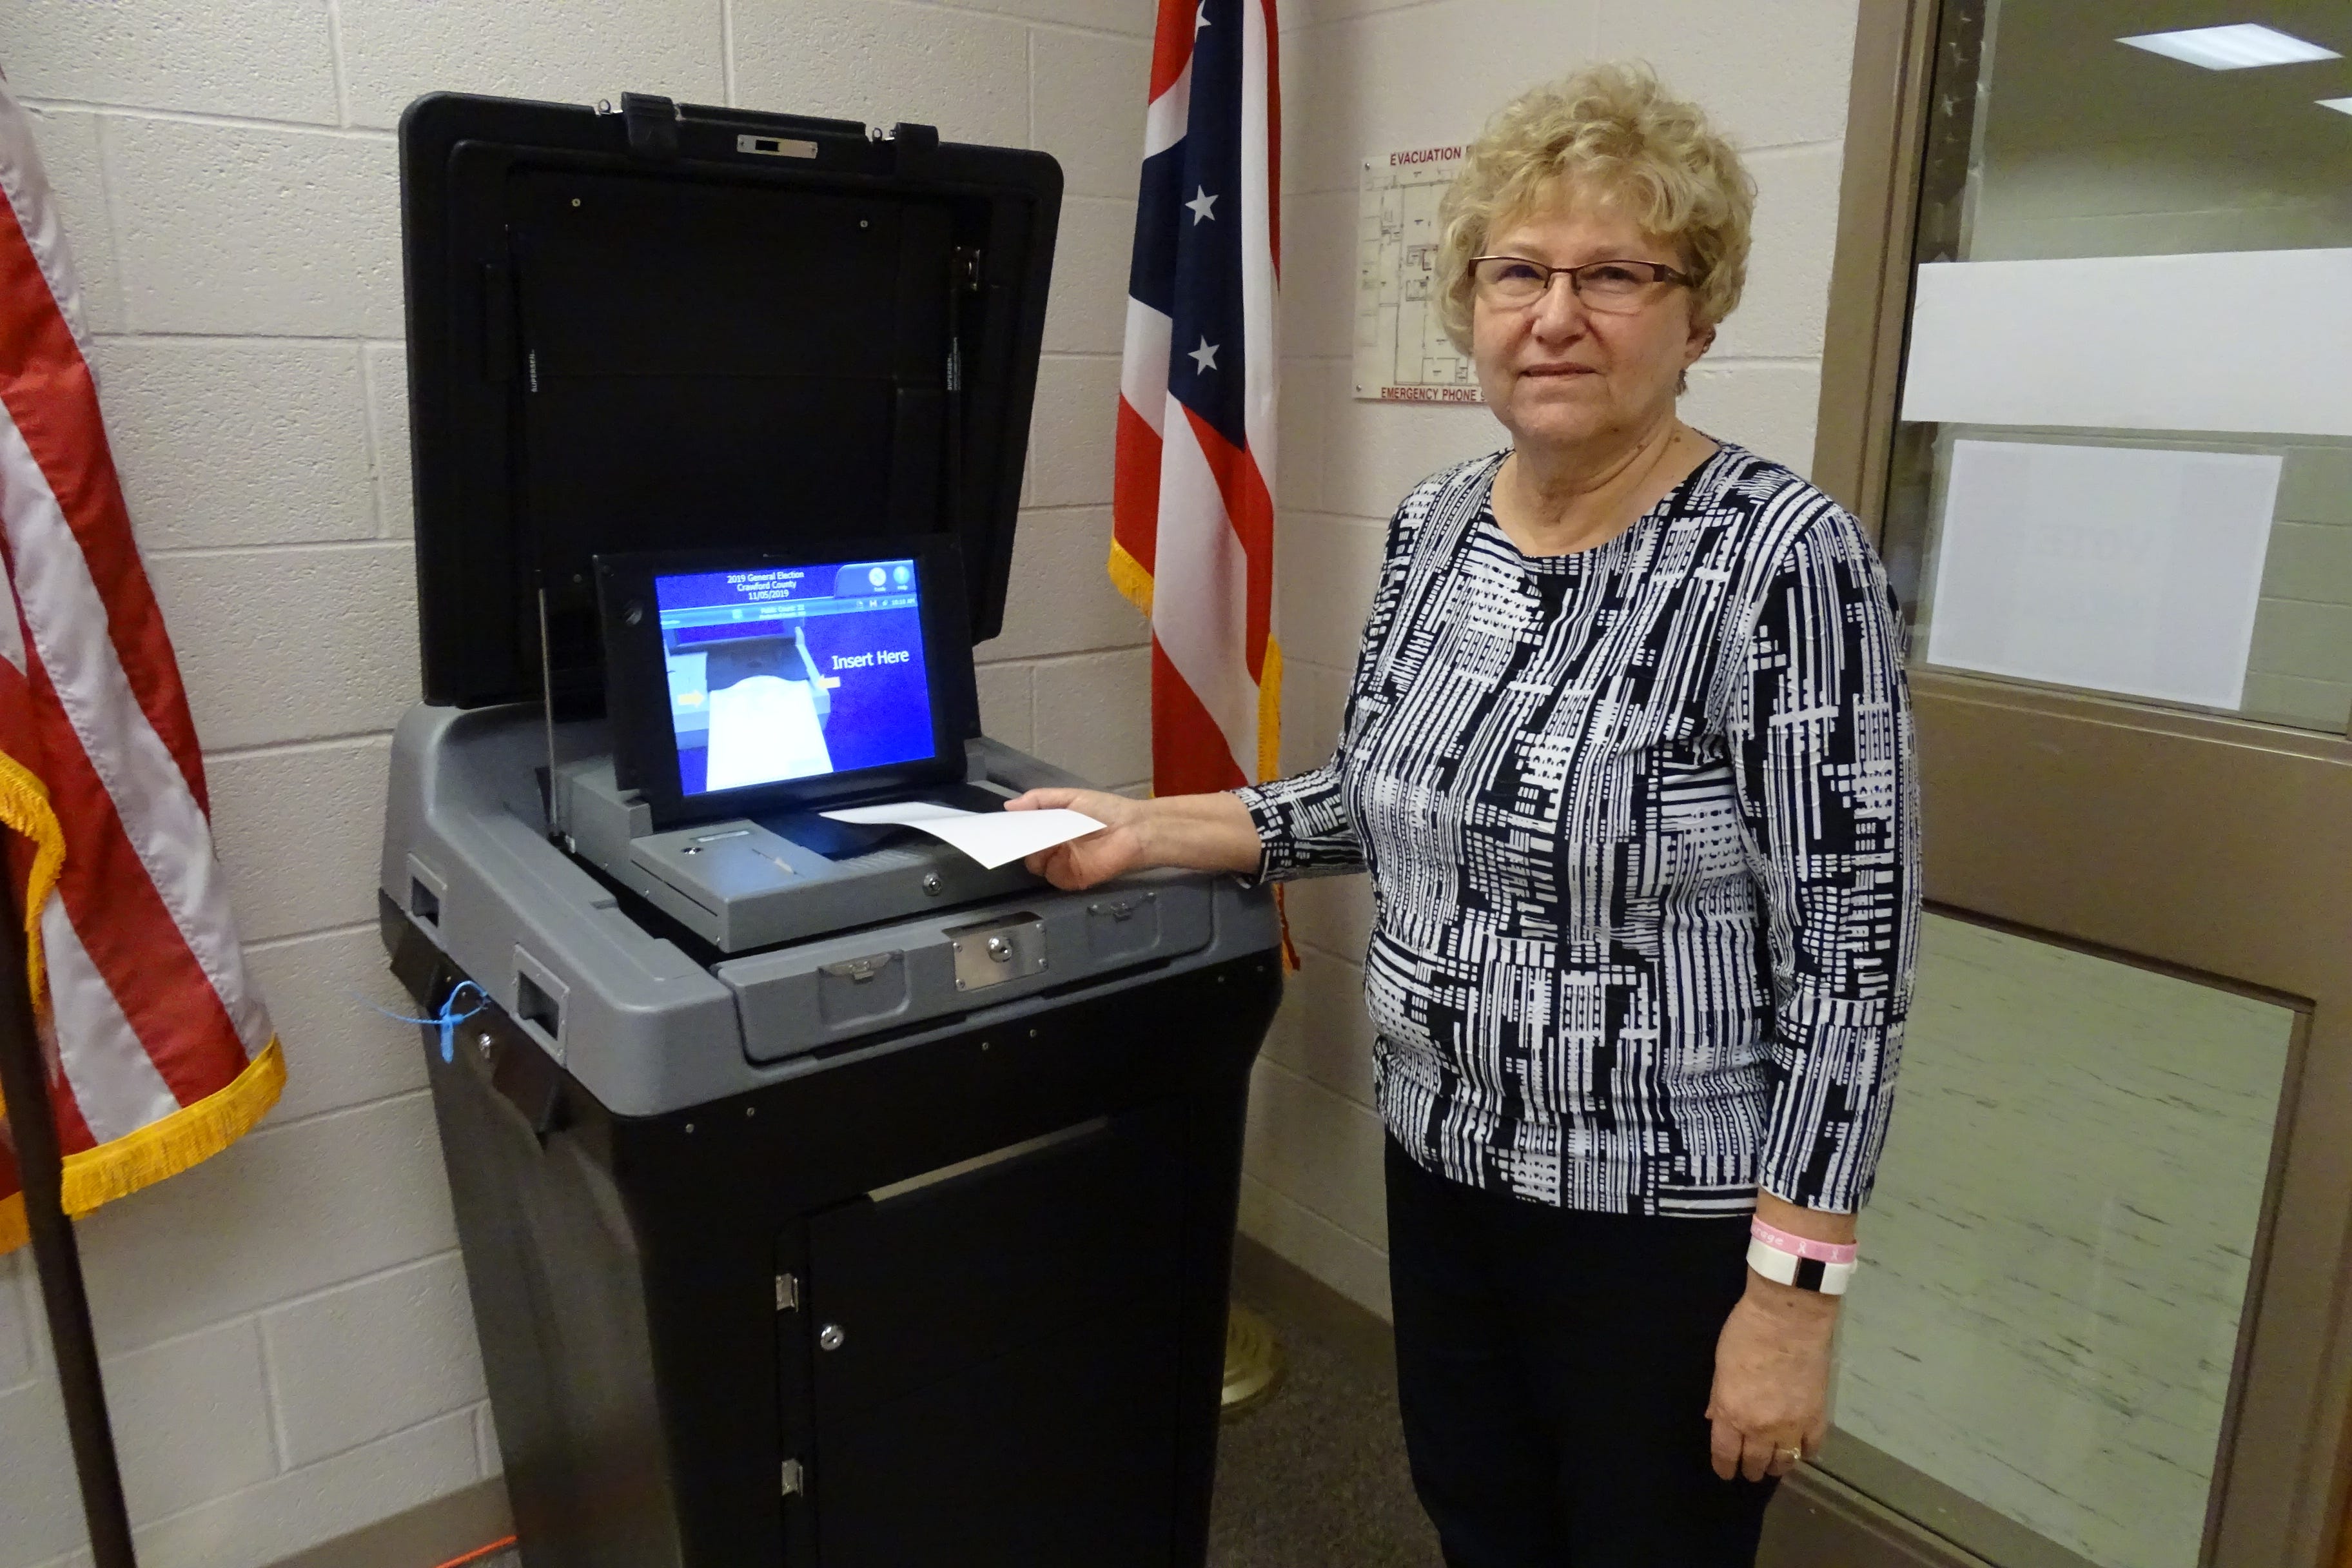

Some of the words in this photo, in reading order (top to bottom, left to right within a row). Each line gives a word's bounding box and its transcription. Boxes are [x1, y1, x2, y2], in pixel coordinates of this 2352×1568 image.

[1390, 146, 1461, 166] EVACUATION
[1381, 387, 1438, 400] EMERGENCY
[1442, 389, 1477, 401] PHONE
[727, 574, 746, 583] 2019
[747, 572, 776, 582] General
[777, 571, 805, 580] Election
[737, 582, 770, 591] Crawford
[749, 589, 789, 600] 11/05/2019
[832, 652, 874, 670] Insert
[877, 650, 910, 665] Here
